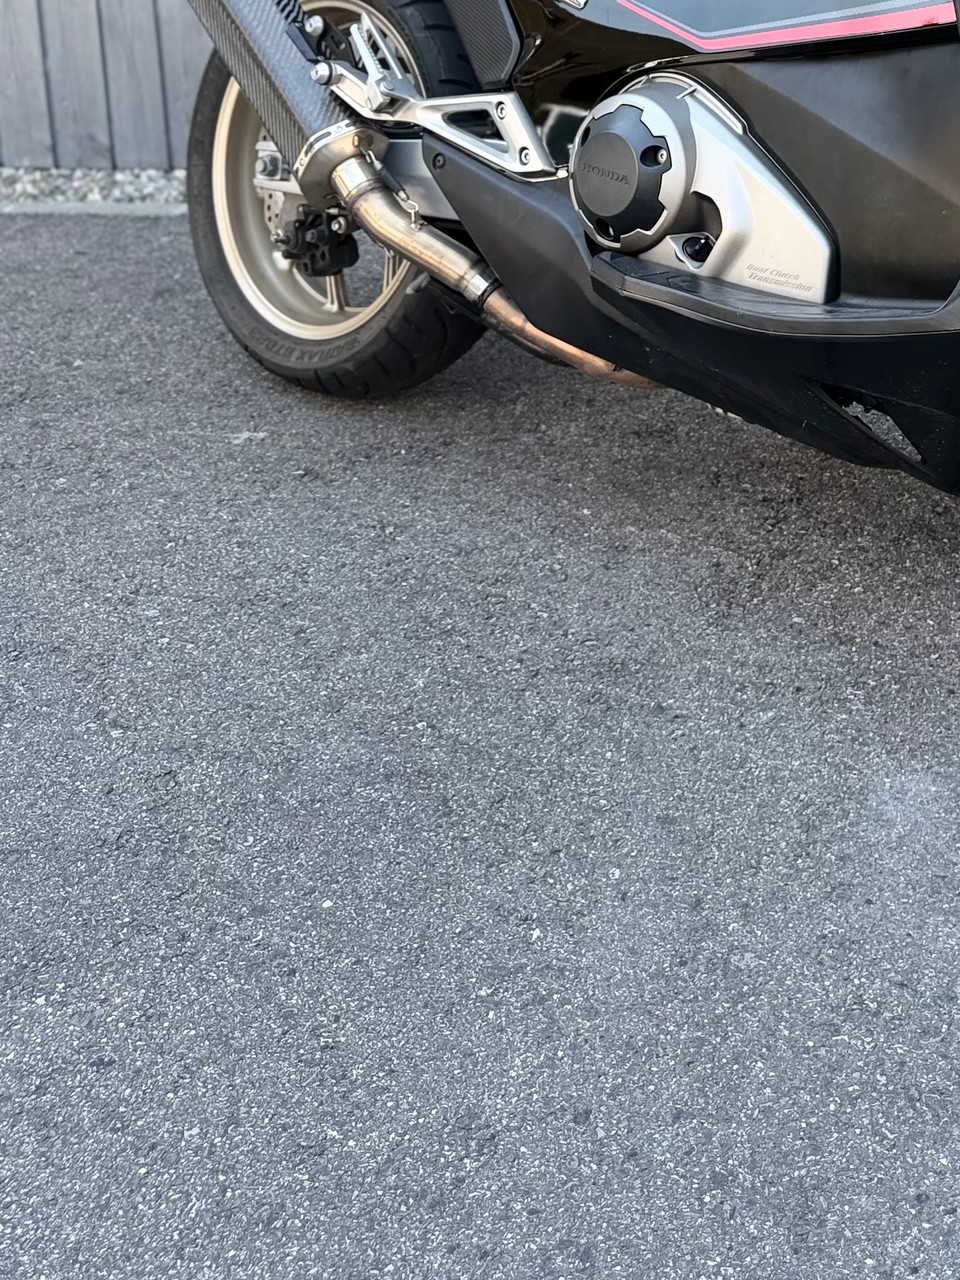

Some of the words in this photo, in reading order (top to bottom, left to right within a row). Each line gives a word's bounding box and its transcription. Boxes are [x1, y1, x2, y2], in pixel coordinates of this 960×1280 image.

[582, 163, 631, 185] HONDA
[746, 263, 769, 274] Dual
[769, 269, 801, 281] Clutch
[748, 272, 813, 292] Transmission
